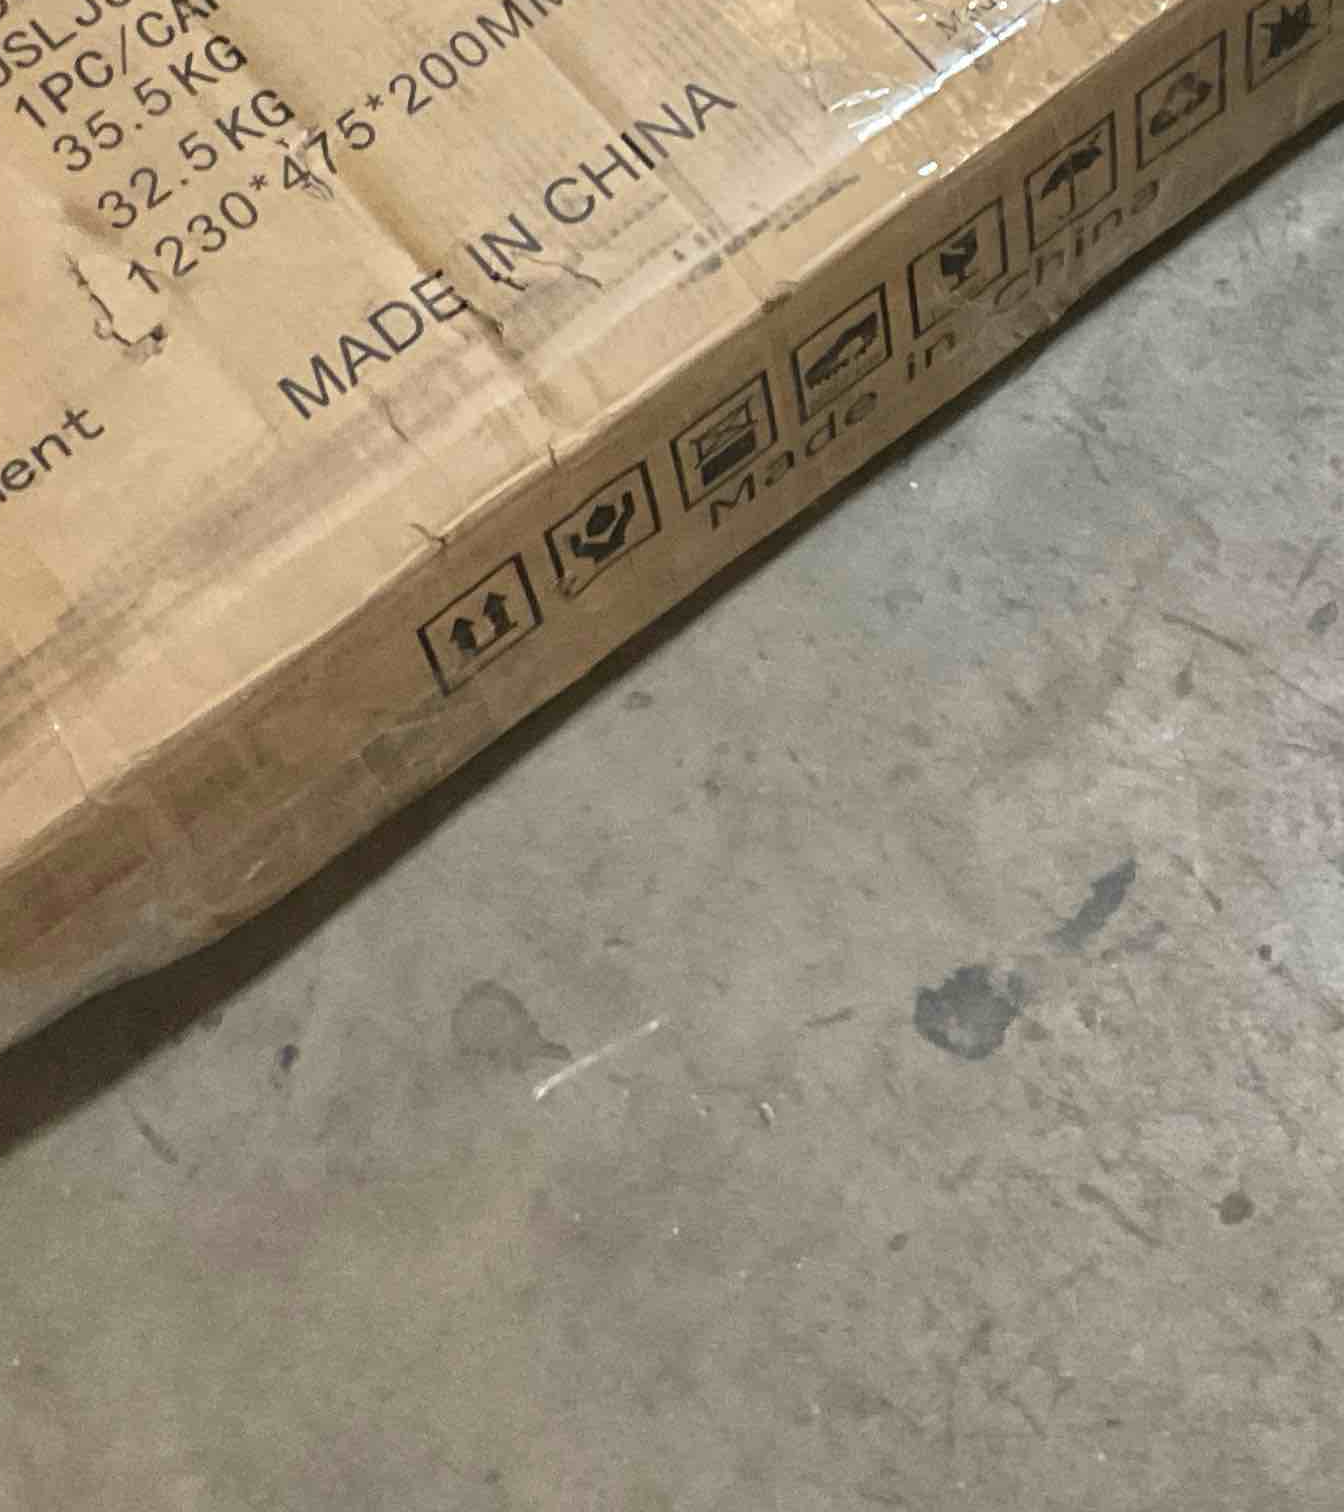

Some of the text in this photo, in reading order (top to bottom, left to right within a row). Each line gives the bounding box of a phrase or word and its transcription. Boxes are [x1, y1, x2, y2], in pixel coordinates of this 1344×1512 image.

[276, 83, 738, 420] MADE IN CHINA
[708, 392, 878, 530] Made
[905, 332, 956, 384] in
